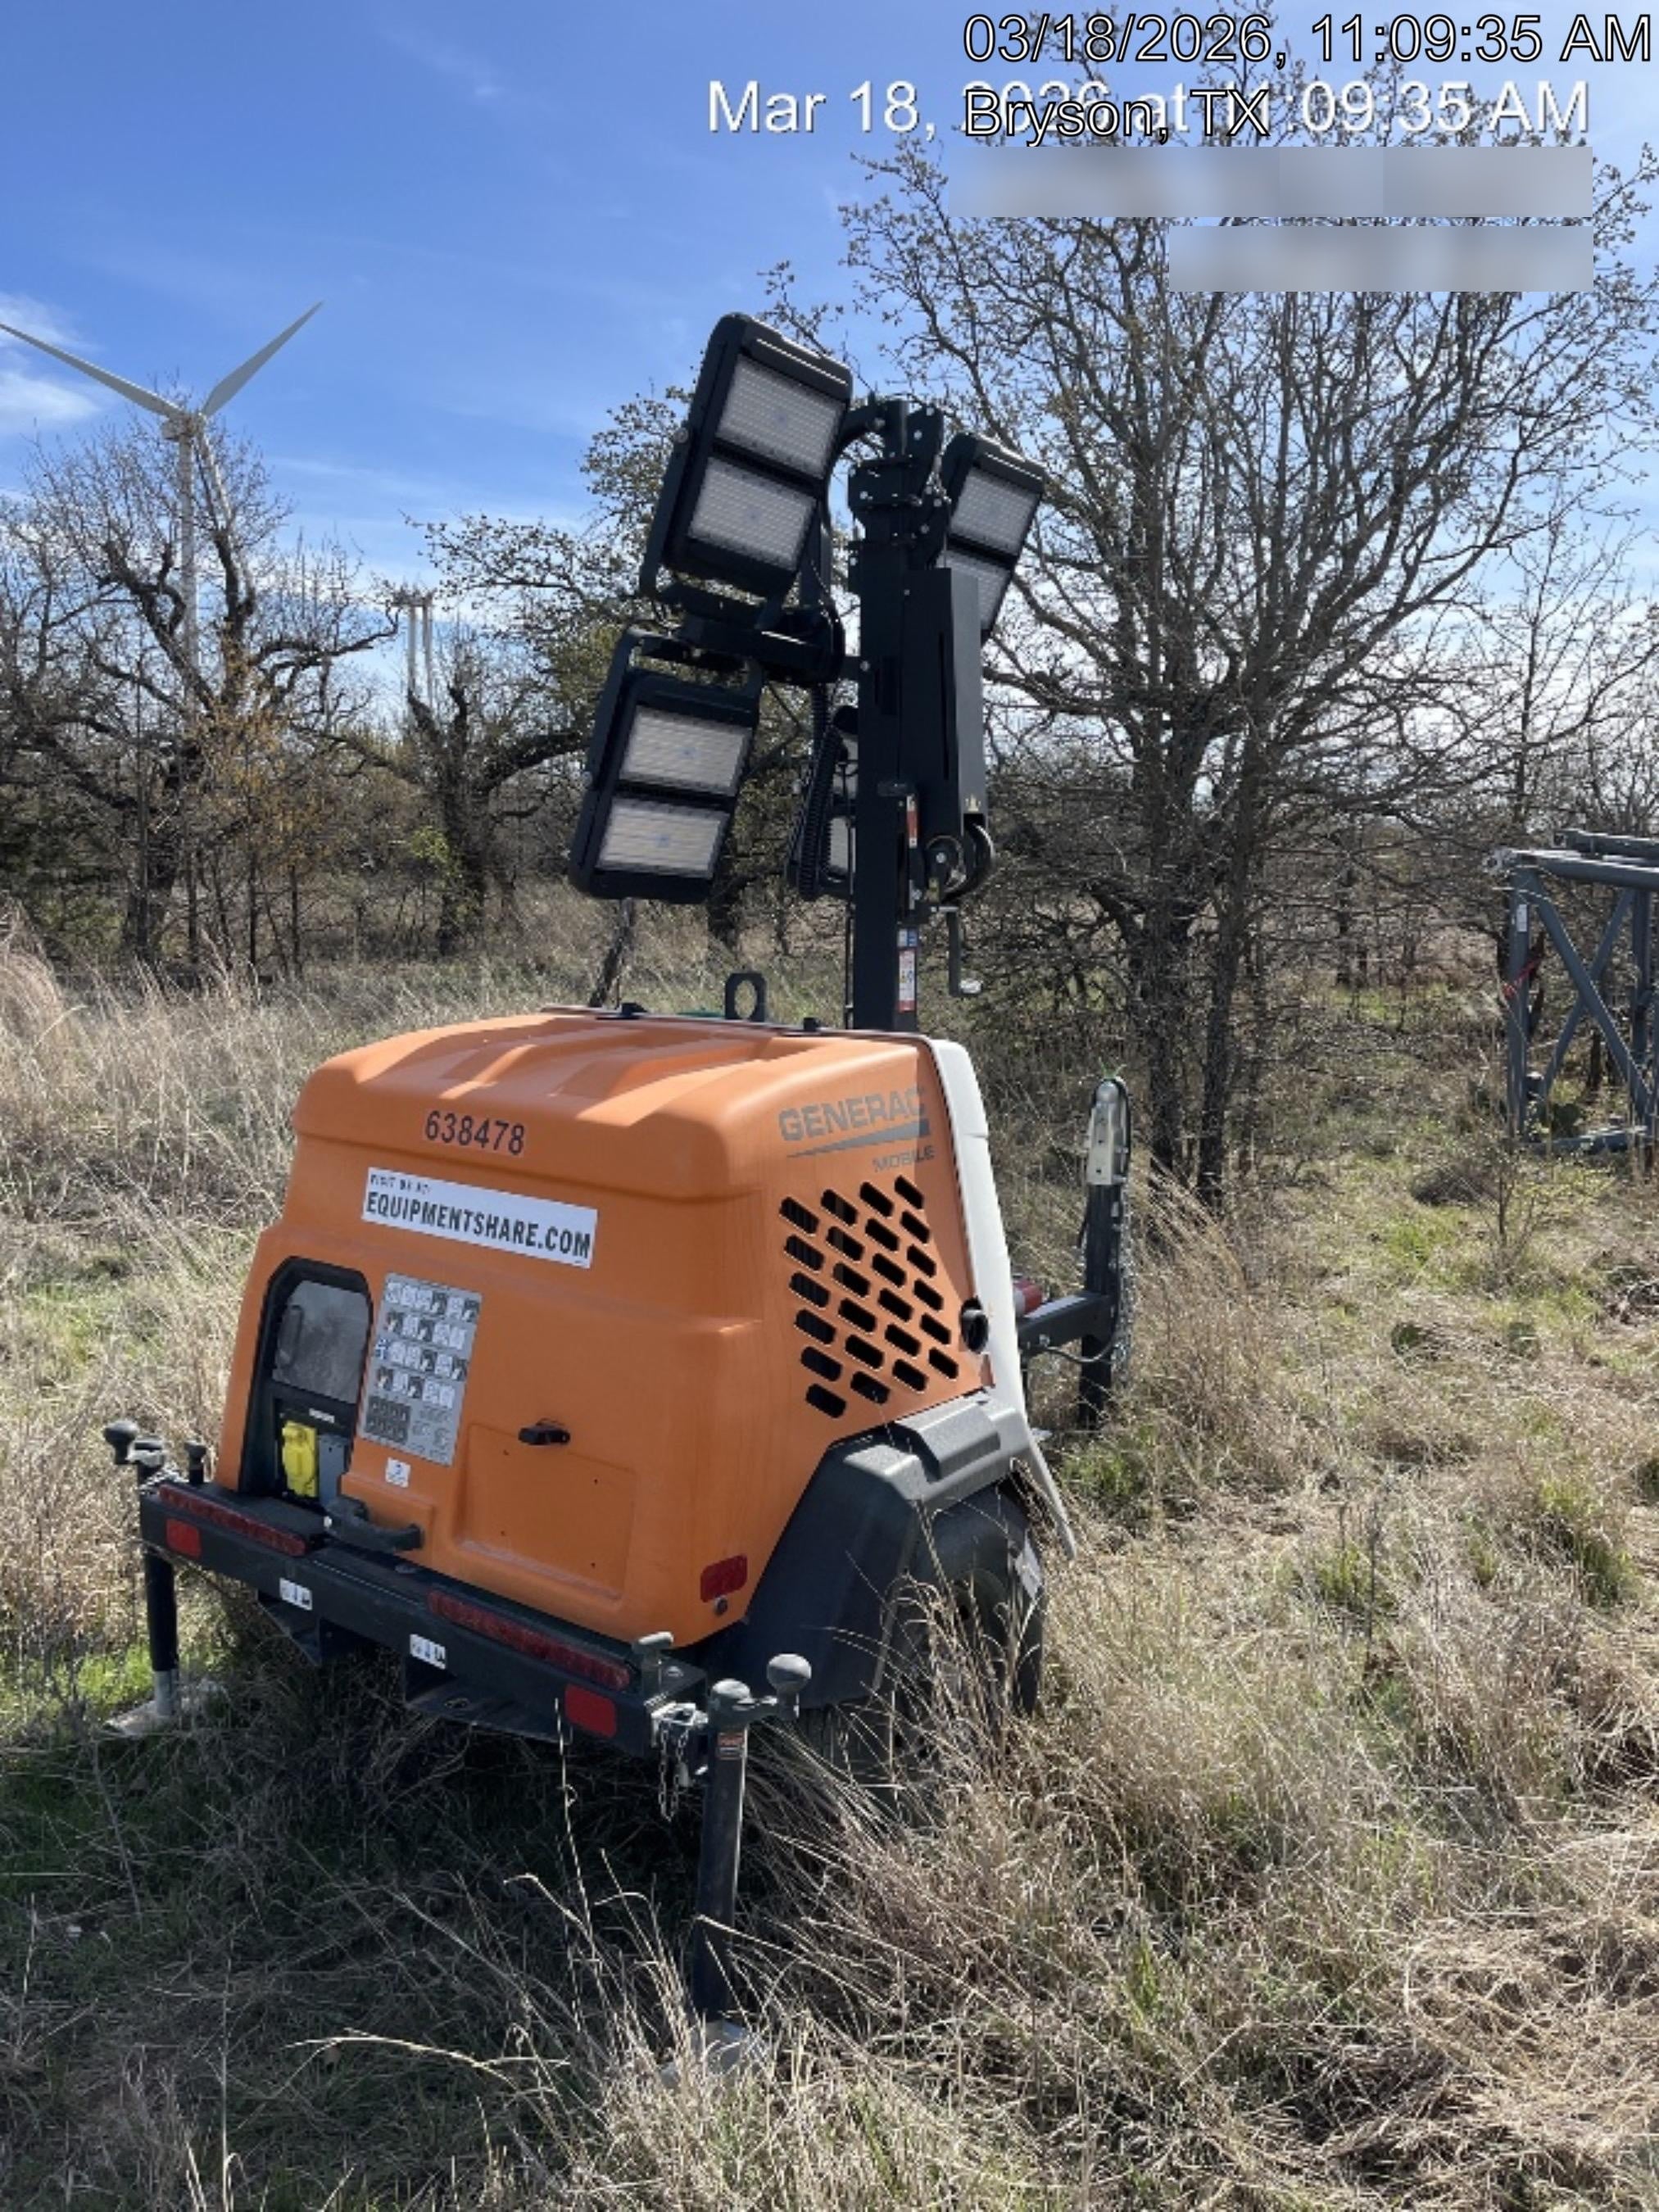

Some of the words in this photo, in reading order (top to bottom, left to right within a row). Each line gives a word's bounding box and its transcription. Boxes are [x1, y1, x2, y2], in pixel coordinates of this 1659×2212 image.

[424, 1110, 525, 1155] 638478
[778, 1086, 926, 1141] GENERAC
[873, 1145, 936, 1172] MOBILE
[365, 1191, 592, 1259] EQUIPMENTSHARE.COM
